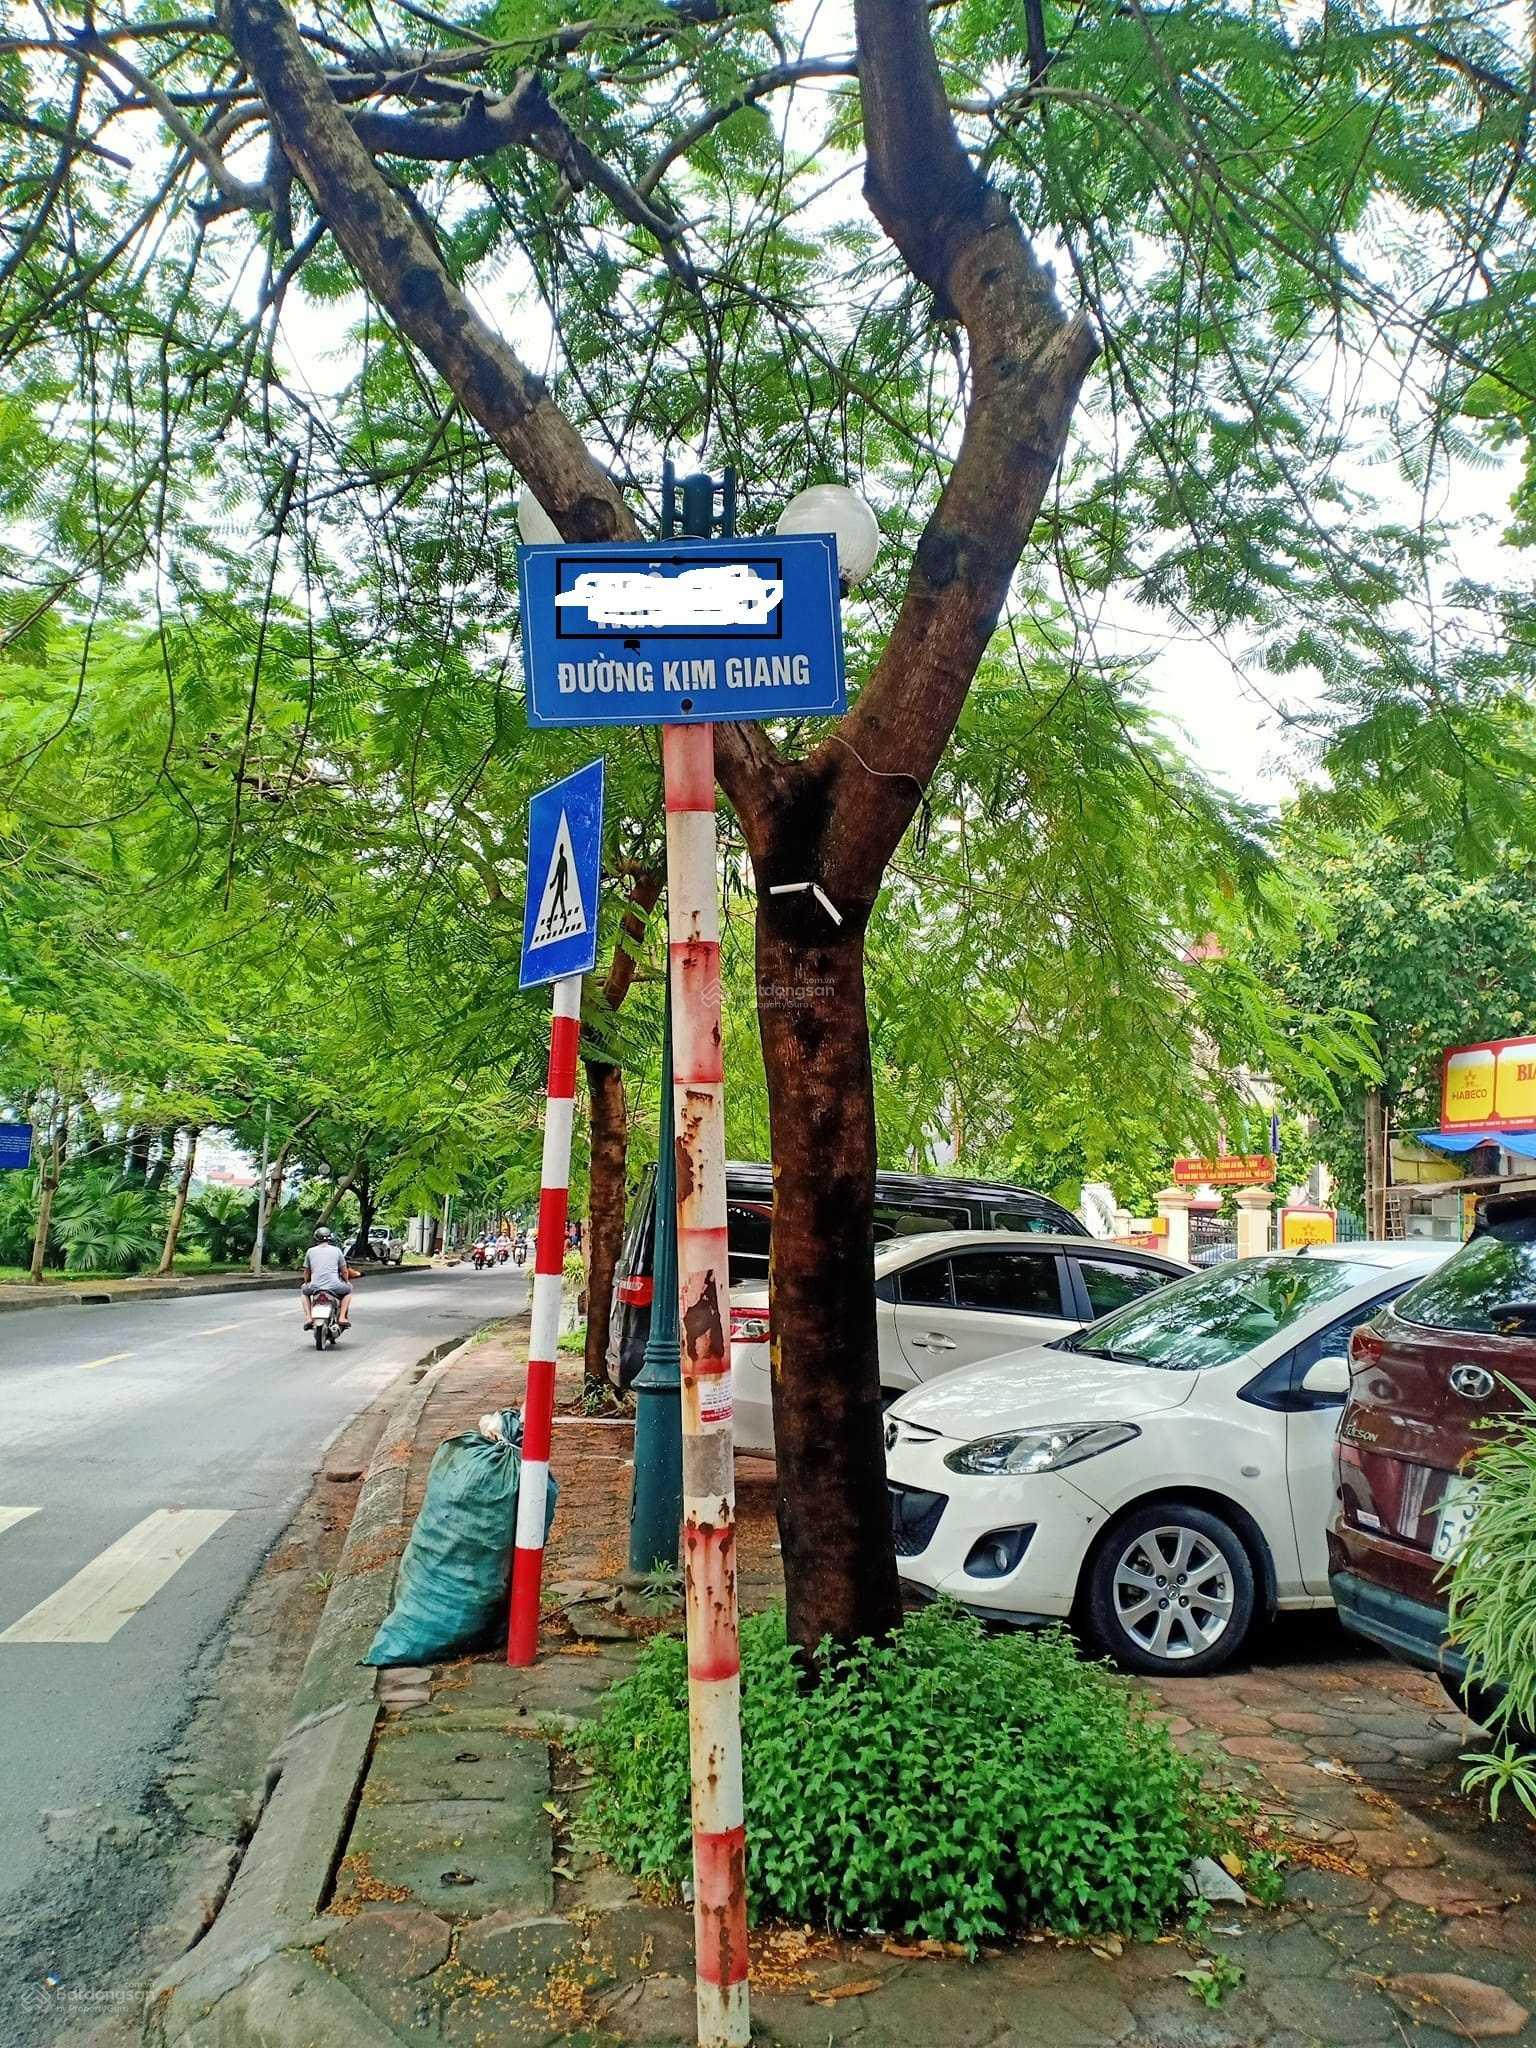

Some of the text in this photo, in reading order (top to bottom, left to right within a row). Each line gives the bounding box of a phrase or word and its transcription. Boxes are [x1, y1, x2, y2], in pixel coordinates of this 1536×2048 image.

[557, 652, 811, 693] ĐƯỜNG KIM GIANG
[1452, 1088, 1488, 1101] HABECO
